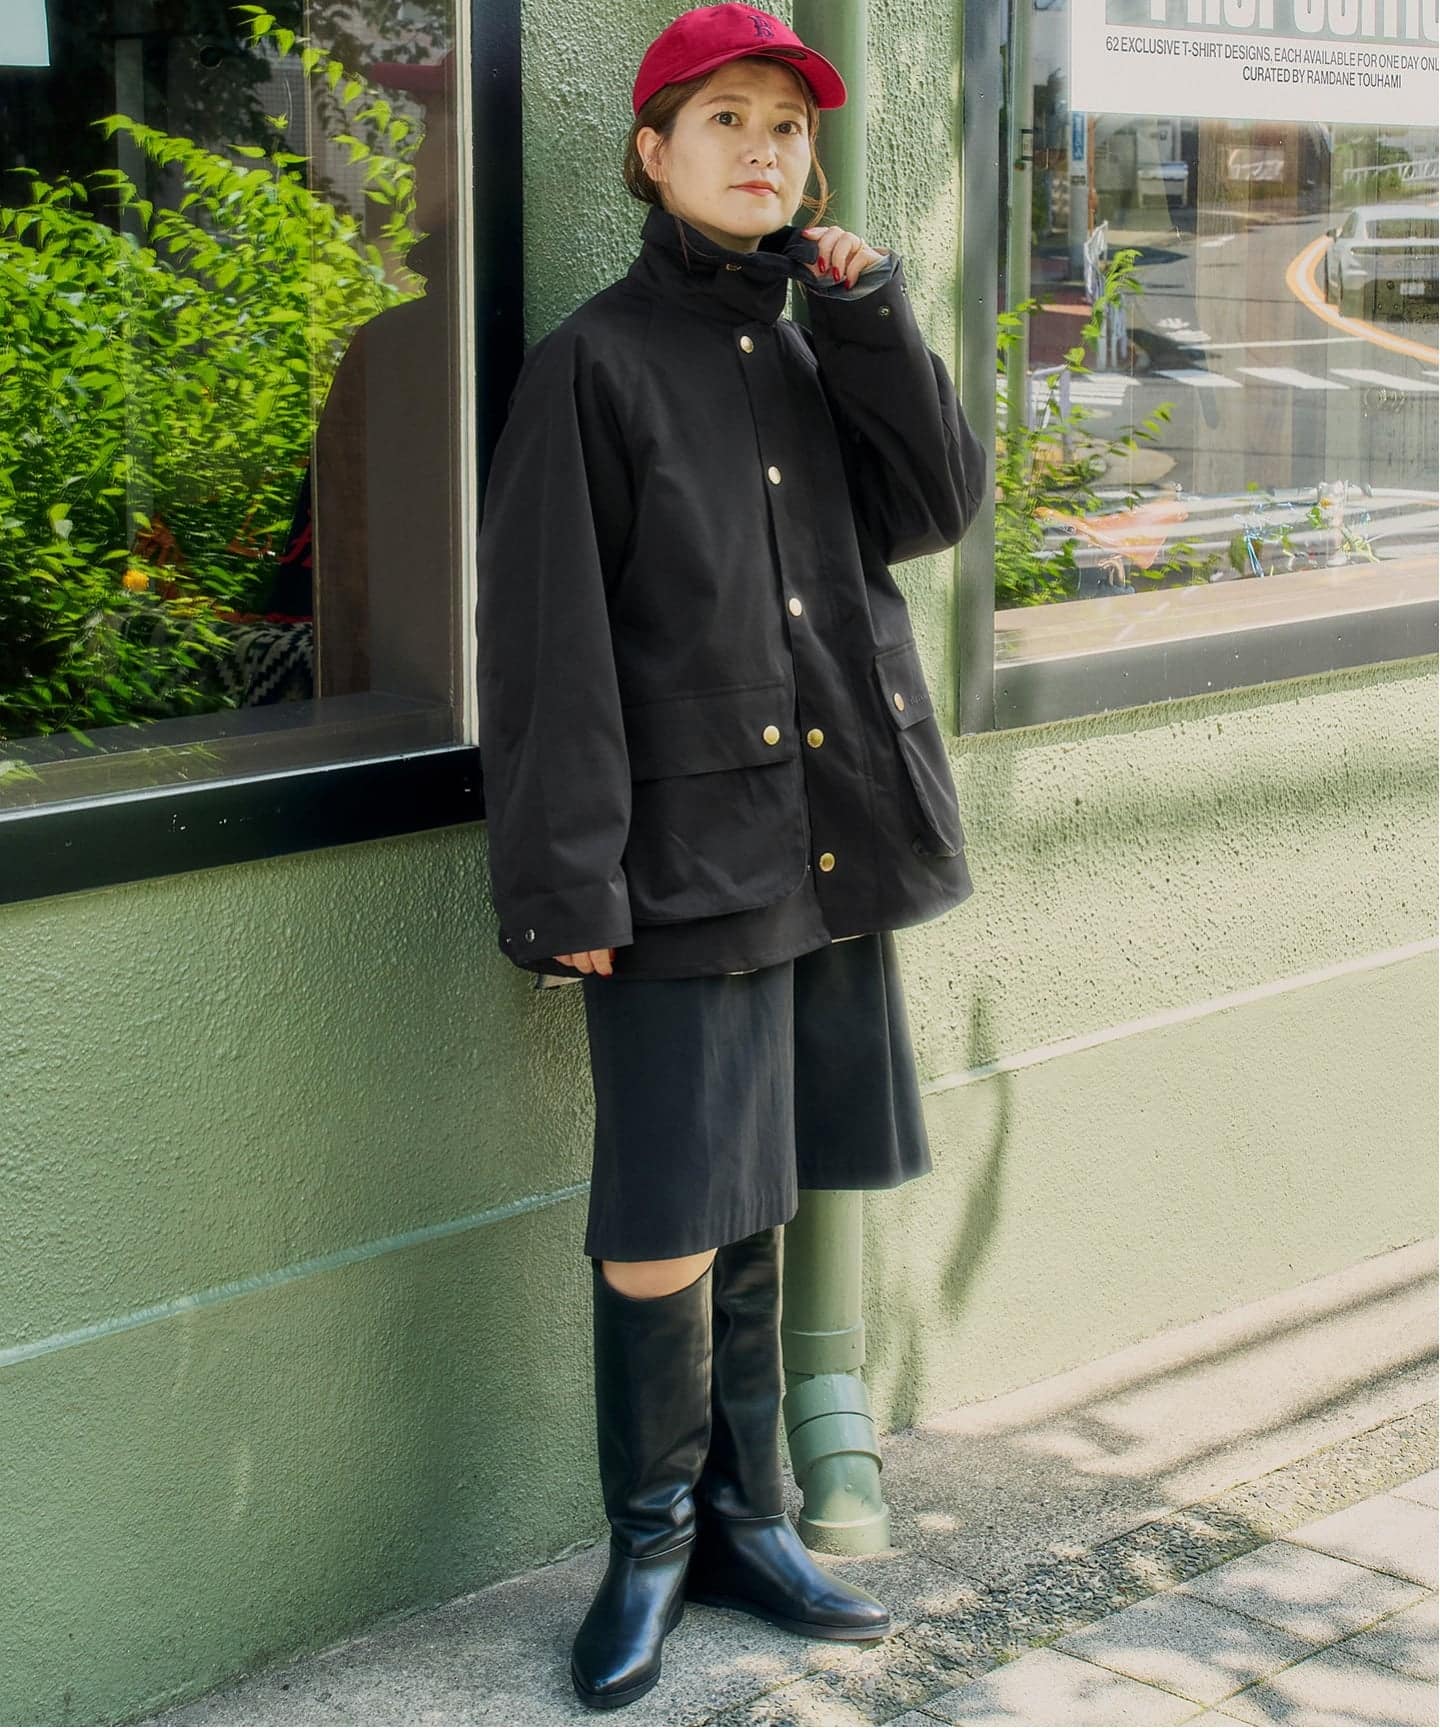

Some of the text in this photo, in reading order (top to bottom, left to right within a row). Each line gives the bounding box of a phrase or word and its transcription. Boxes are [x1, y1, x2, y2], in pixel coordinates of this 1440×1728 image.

[1106, 36, 1119, 51] 62
[1121, 37, 1180, 55] EXCLUSIVE
[1182, 41, 1223, 58] T-SHIRT
[1225, 44, 1272, 61] DESIGNS.
[1275, 48, 1301, 63] EACH
[1304, 50, 1355, 66] AVAILABLE
[1358, 53, 1377, 67] FOR
[1379, 54, 1399, 69] ONE
[1401, 55, 1420, 70] DAY
[1243, 66, 1402, 88] CURATED BY RAMDANE TOUHAMI
